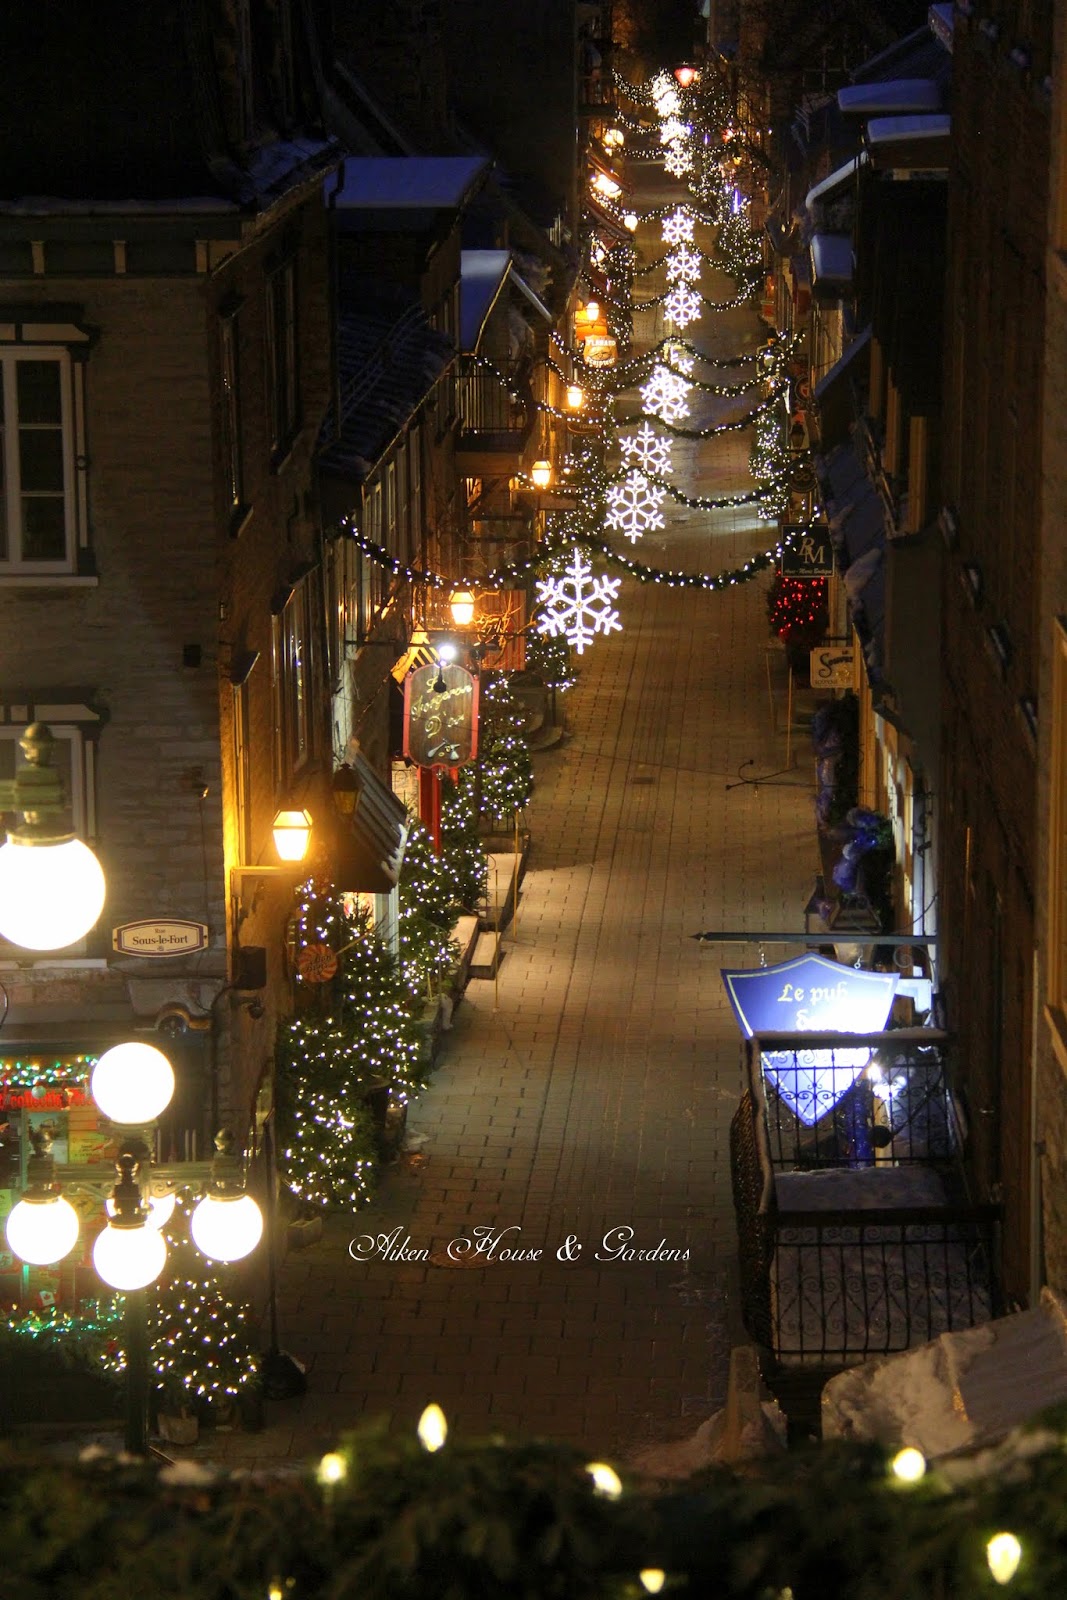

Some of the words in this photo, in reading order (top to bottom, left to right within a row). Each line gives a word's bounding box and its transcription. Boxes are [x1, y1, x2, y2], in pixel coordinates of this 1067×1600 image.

[132, 934, 188, 945] Sous-le-Fort
[777, 983, 804, 1002] Le
[810, 981, 850, 1006] pub
